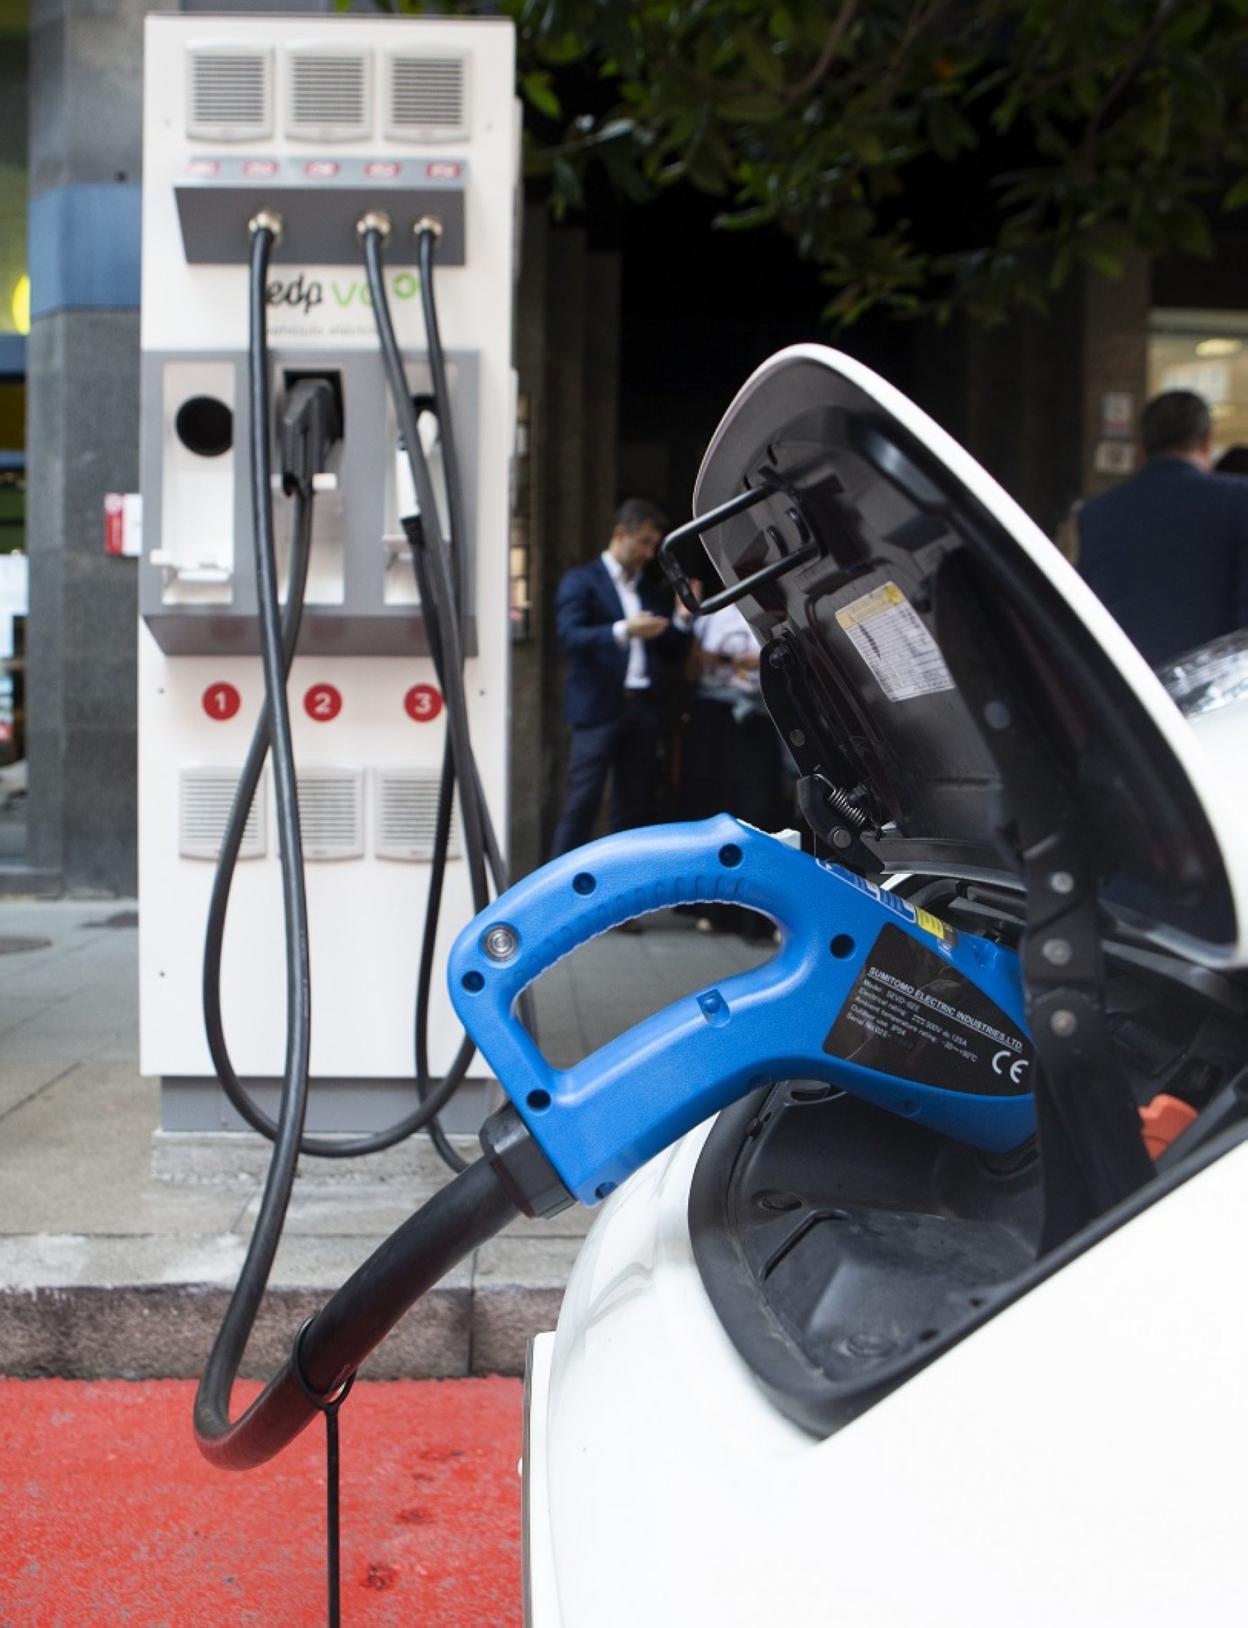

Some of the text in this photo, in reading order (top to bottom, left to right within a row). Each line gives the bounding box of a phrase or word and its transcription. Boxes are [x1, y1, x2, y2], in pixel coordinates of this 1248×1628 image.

[266, 273, 322, 313] edp
[214, 691, 227, 713] 1
[314, 692, 332, 715] 2
[414, 692, 432, 715] 3
[858, 986, 888, 1006] Electrical
[868, 966, 914, 995] SUMITOMO
[914, 989, 956, 1016] ELECTRIC
[855, 994, 881, 1013] Ambient
[880, 1008, 919, 1033] temperature
[991, 1049, 1030, 1084] CE
